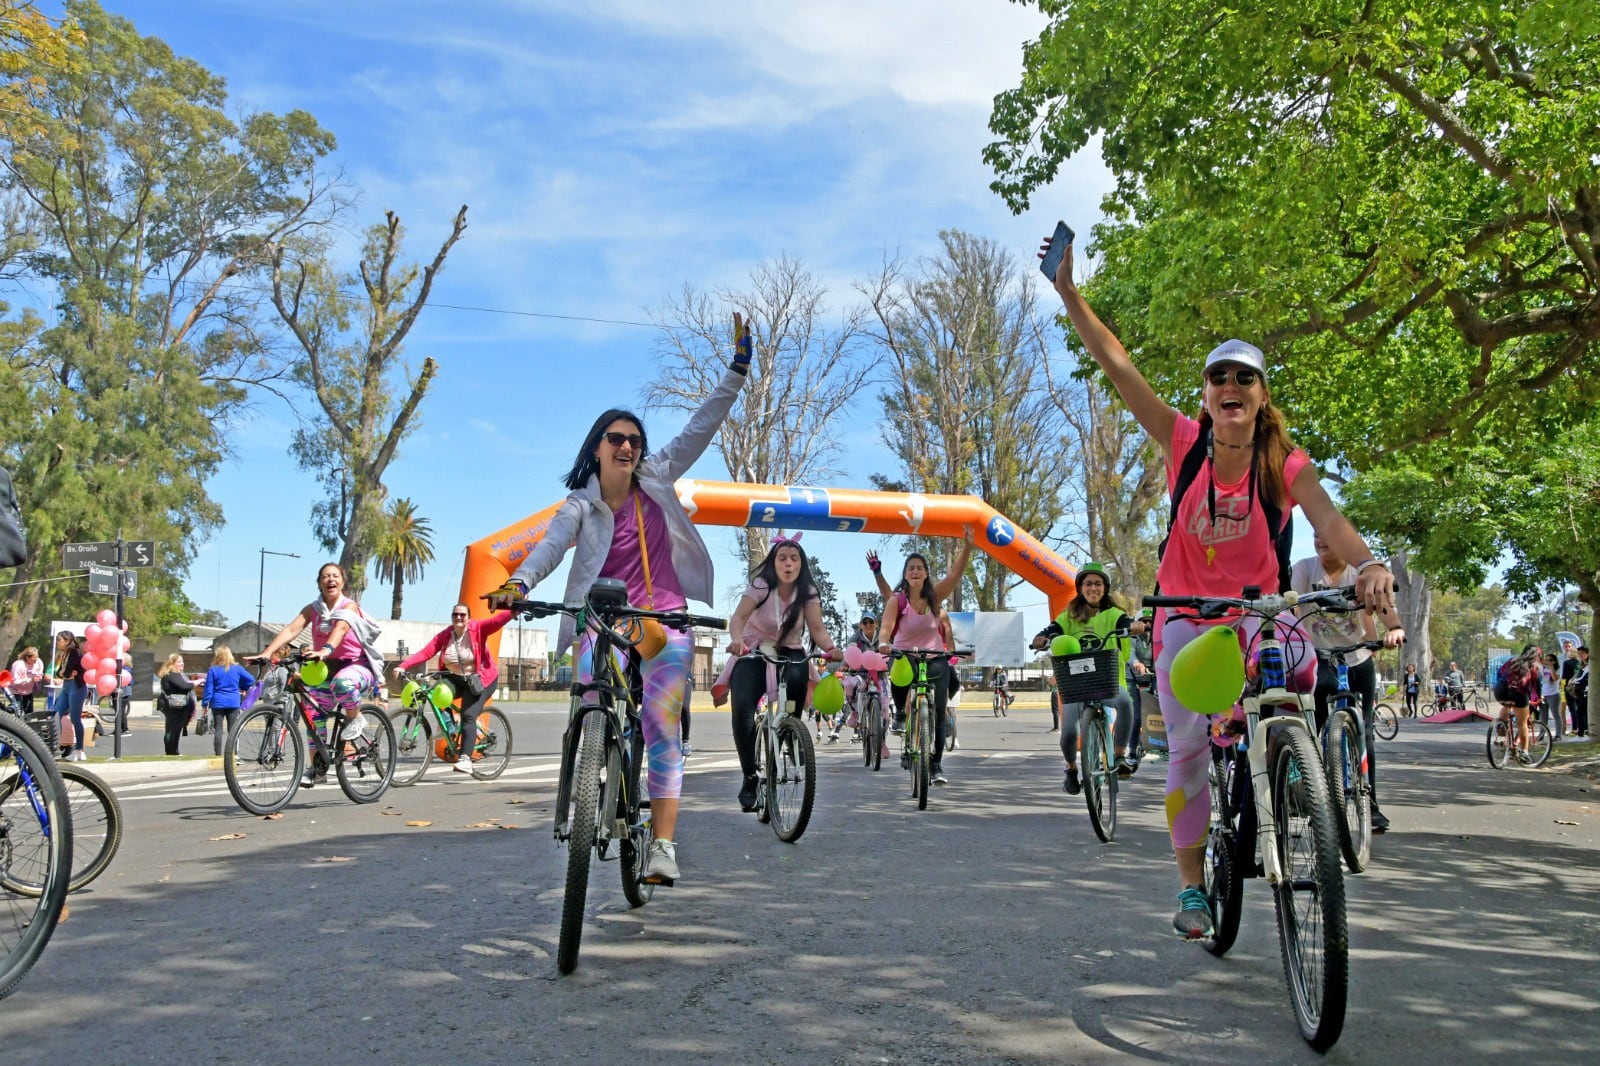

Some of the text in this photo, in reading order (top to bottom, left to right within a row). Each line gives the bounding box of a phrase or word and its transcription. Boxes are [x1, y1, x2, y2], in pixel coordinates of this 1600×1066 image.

[762, 506, 776, 522] 2
[837, 520, 851, 531] 3
[66, 544, 98, 553] Bv. Oroño
[508, 549, 524, 561] de
[1018, 549, 1065, 586] de Rosario
